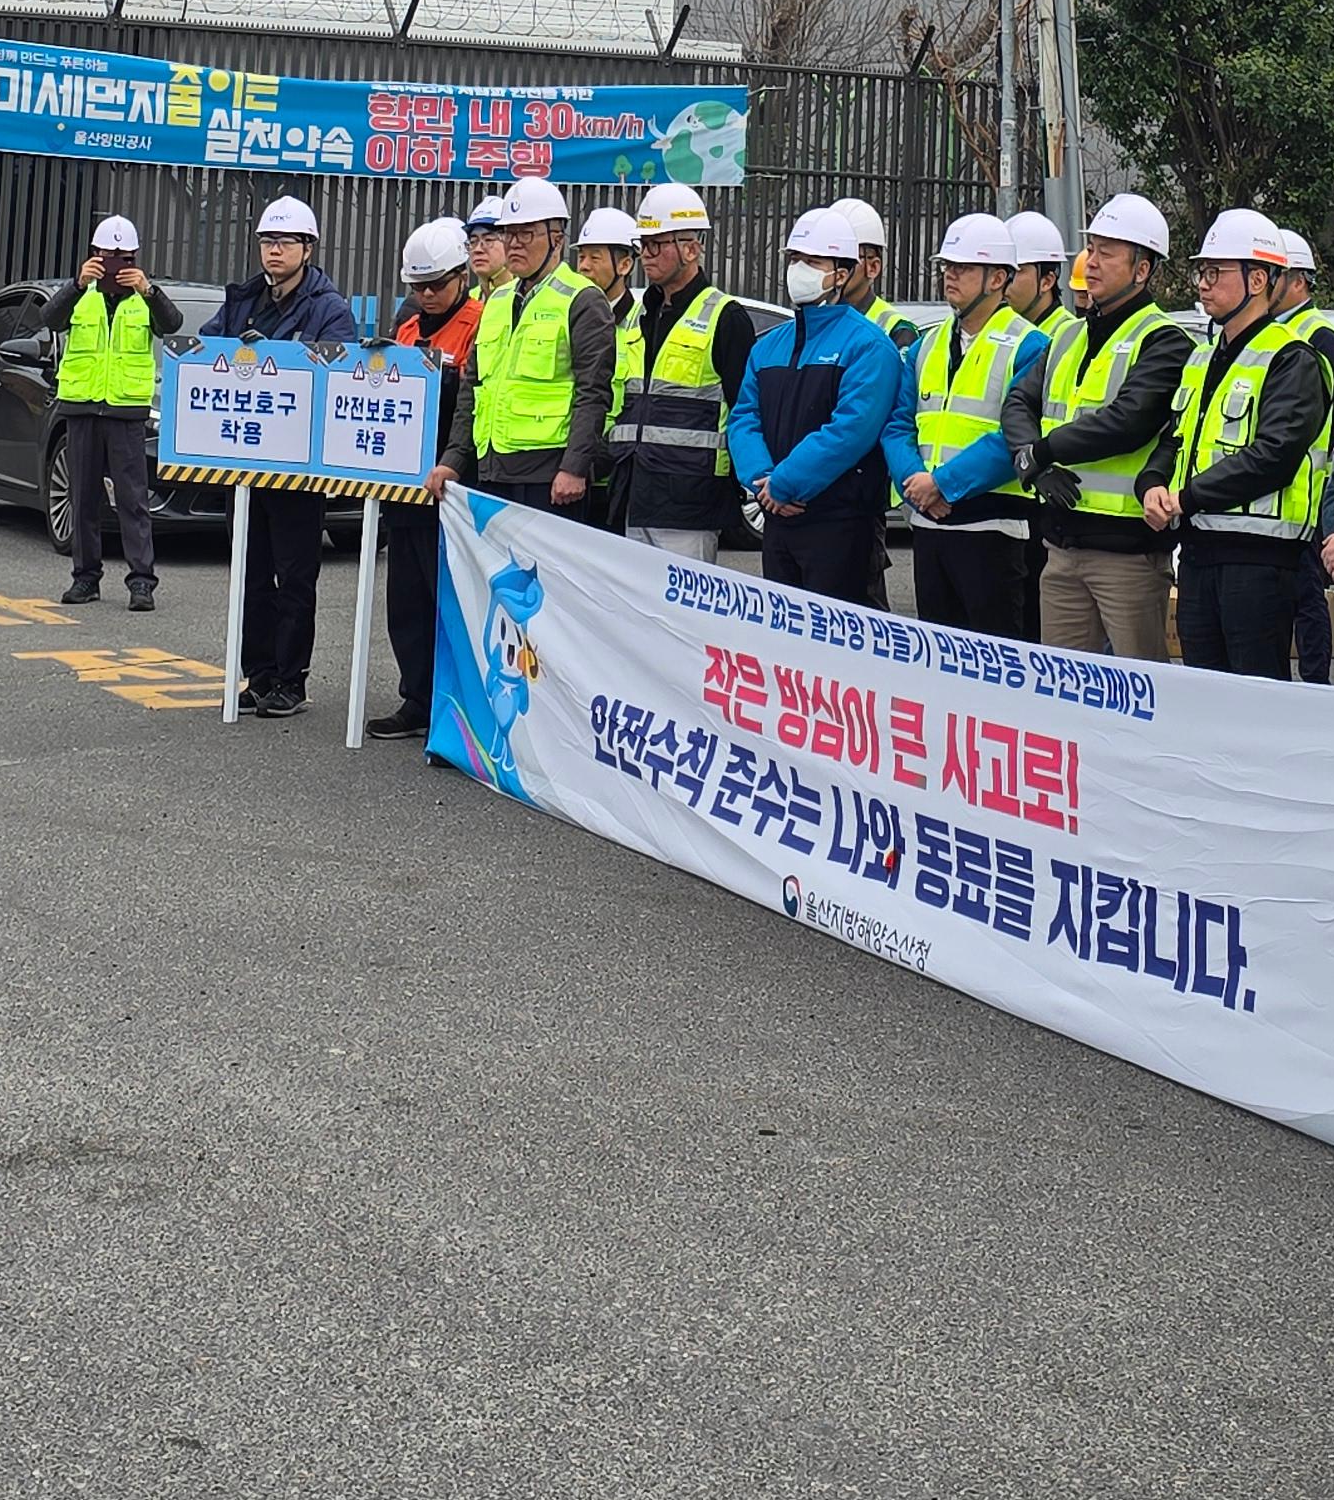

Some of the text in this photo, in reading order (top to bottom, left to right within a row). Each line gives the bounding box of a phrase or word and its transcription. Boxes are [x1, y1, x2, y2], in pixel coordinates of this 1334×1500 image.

[20, 50, 58, 67] 만드는
[204, 108, 354, 170] 실천약속
[368, 93, 645, 140] 항만 내 30km/h
[74, 130, 152, 151] 울산항만공사
[365, 134, 553, 179] 이하 주행
[190, 386, 297, 416] 안전보호구
[334, 394, 413, 424] 안전보호구
[220, 418, 263, 445] 착용
[355, 428, 387, 456] 착용
[664, 564, 1155, 721] 항만안전사고 없는 울산항 만들기 민관합동 안전캠페인
[703, 643, 1079, 835] 작은 방심이 큰 사고로!
[591, 694, 1256, 1013] 안전수칙 준수는 나와 동료를 지킵니다.
[805, 891, 932, 972] 울산지방해양수산청
